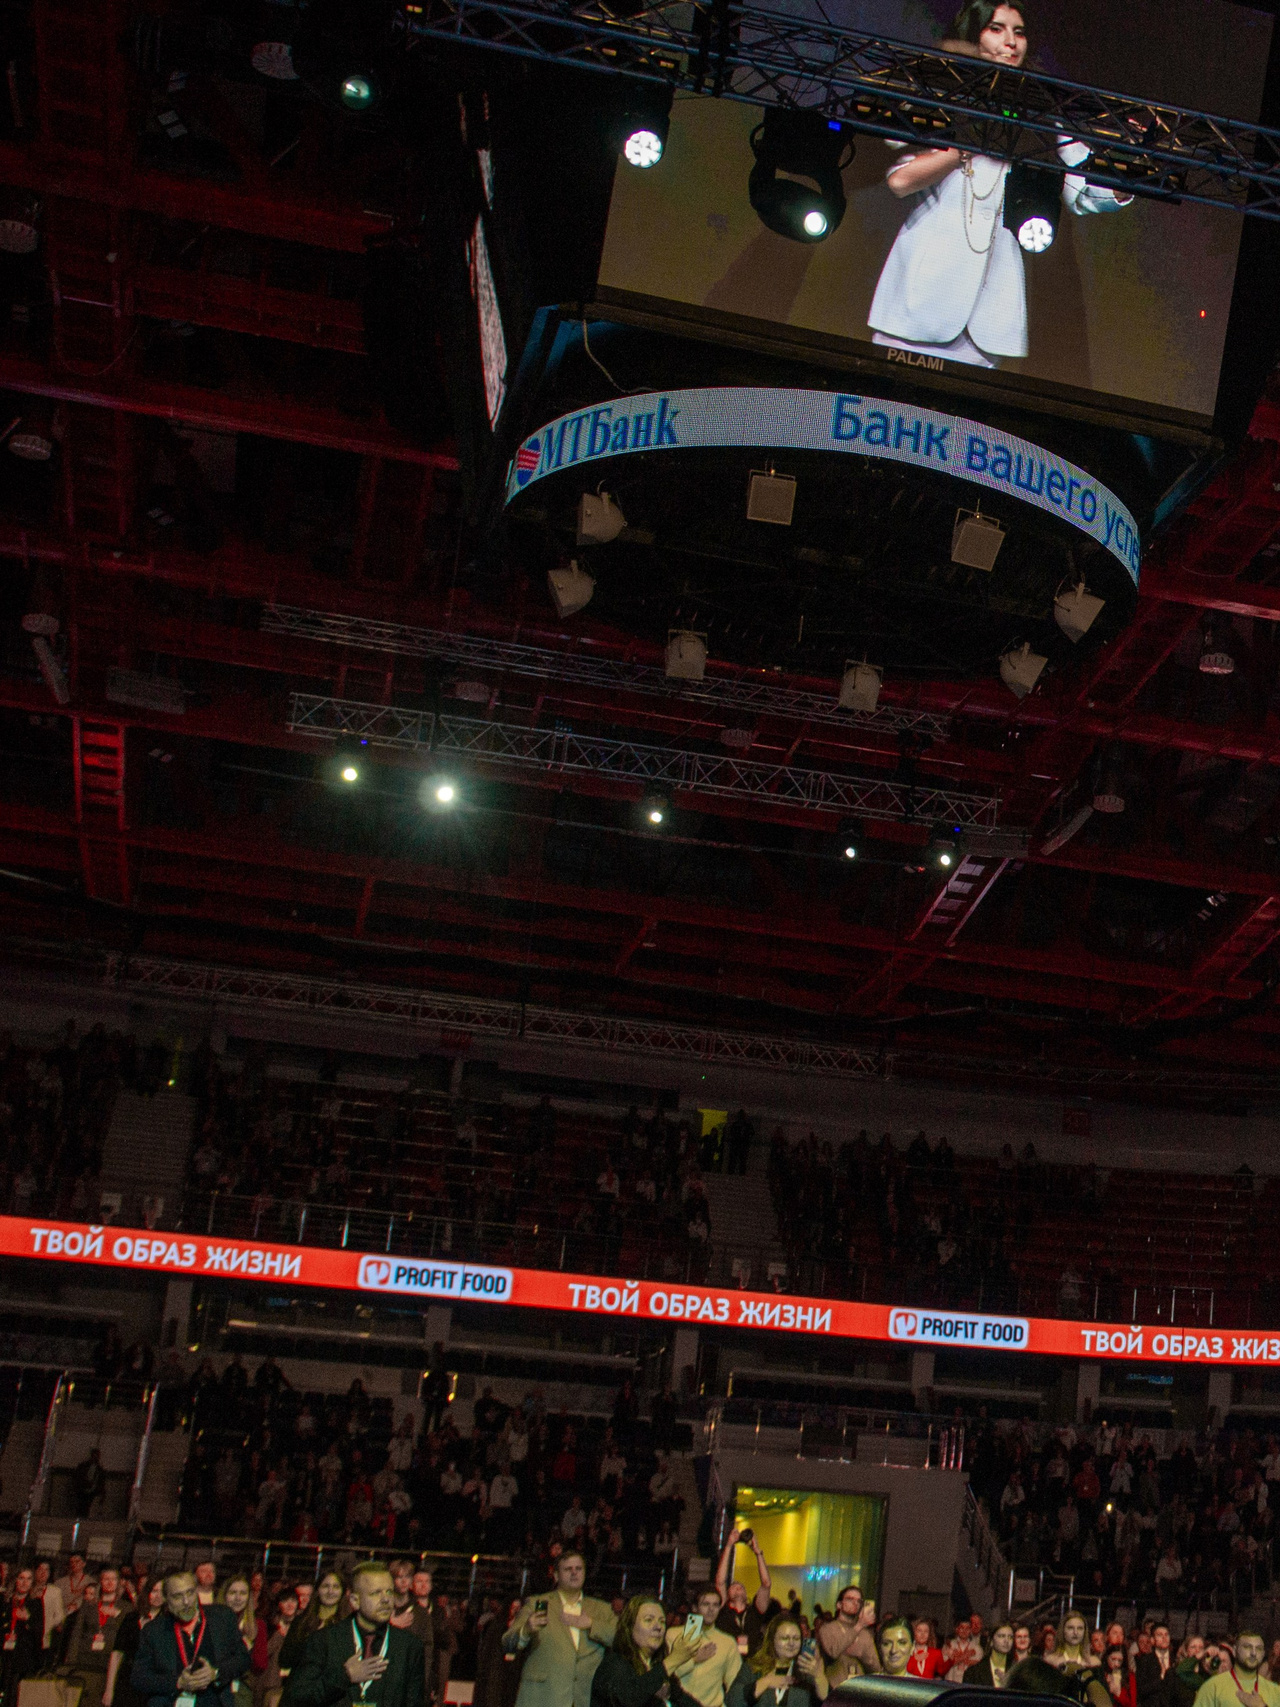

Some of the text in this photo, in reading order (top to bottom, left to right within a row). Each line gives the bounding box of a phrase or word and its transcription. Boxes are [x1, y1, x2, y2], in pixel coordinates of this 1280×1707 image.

[886, 348, 945, 372] PALAMI
[831, 393, 1140, 576] Банк вашего успе
[30, 1225, 302, 1278] ТВОЙ ОБРАЗ ЖИЗНИ
[395, 1266, 507, 1294] PROFIT FOOD
[568, 1280, 832, 1332] ТВОЙ ОБРАЗ ЖИЗНИ
[922, 1317, 1024, 1342] PROFIT FOOD
[1081, 1325, 1143, 1354] ТВОЙ
[1152, 1334, 1224, 1358] ОБРАЗ
